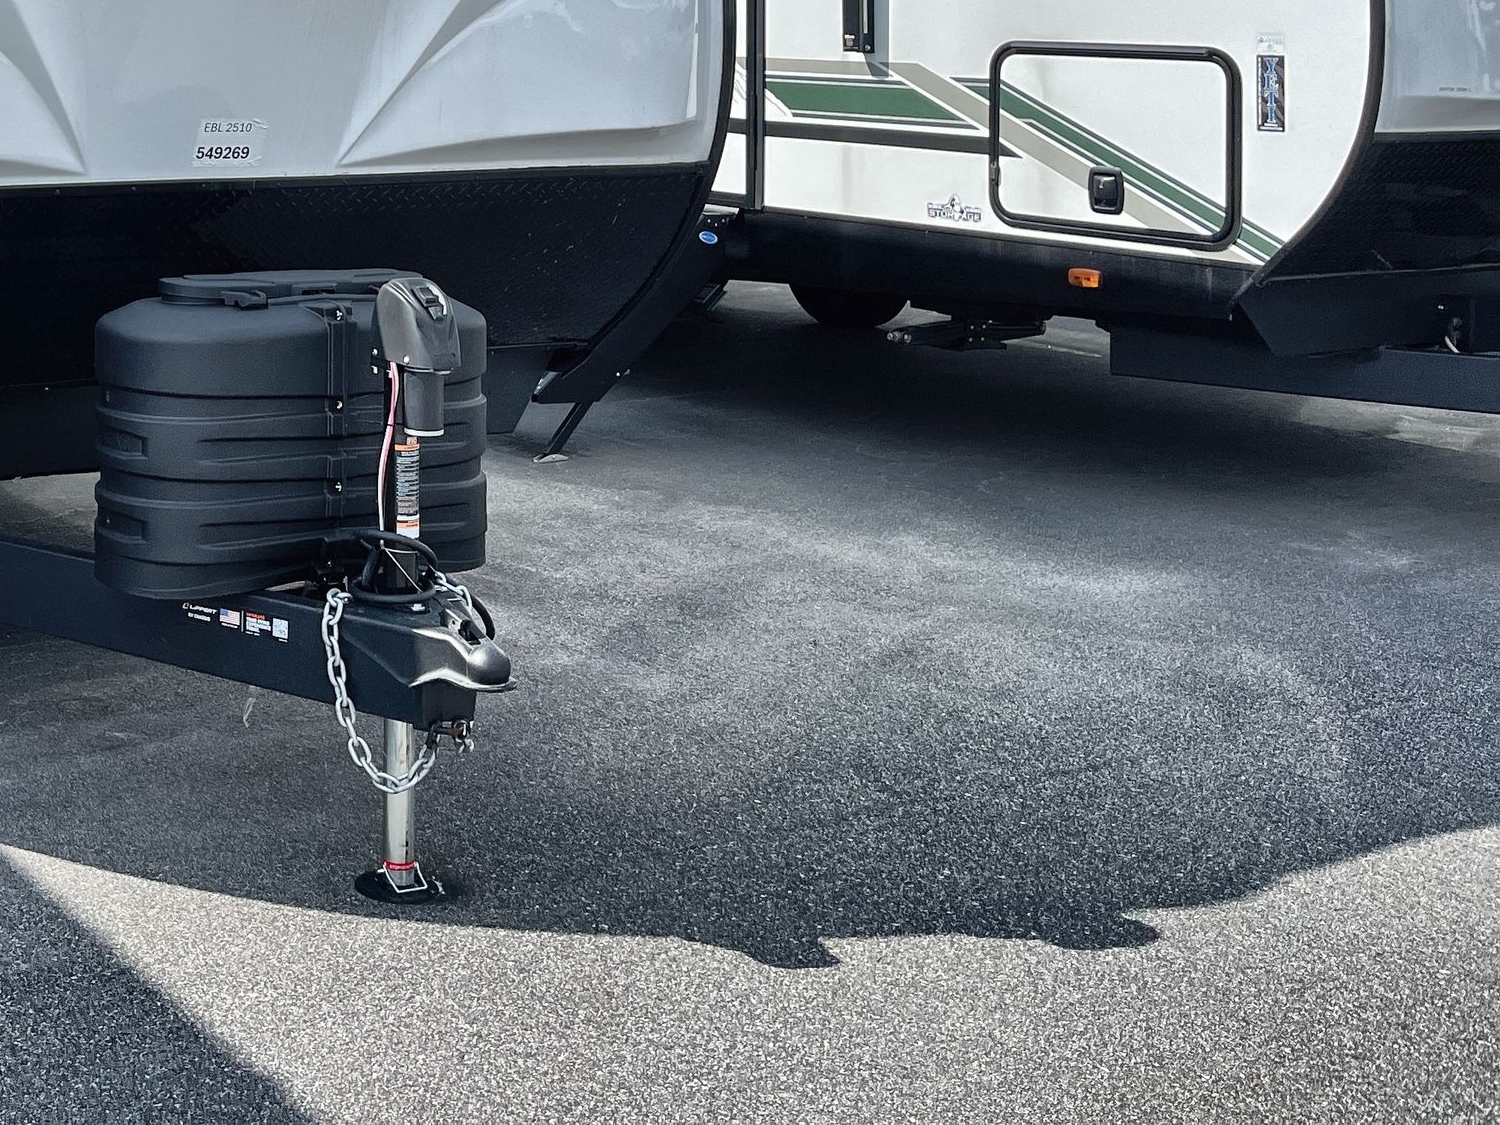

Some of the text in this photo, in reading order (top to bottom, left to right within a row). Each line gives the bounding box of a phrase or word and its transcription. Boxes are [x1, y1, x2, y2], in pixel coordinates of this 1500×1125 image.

[1263, 57, 1279, 124] YETI
[204, 122, 252, 133] EBL 2510
[196, 146, 250, 160] 549269
